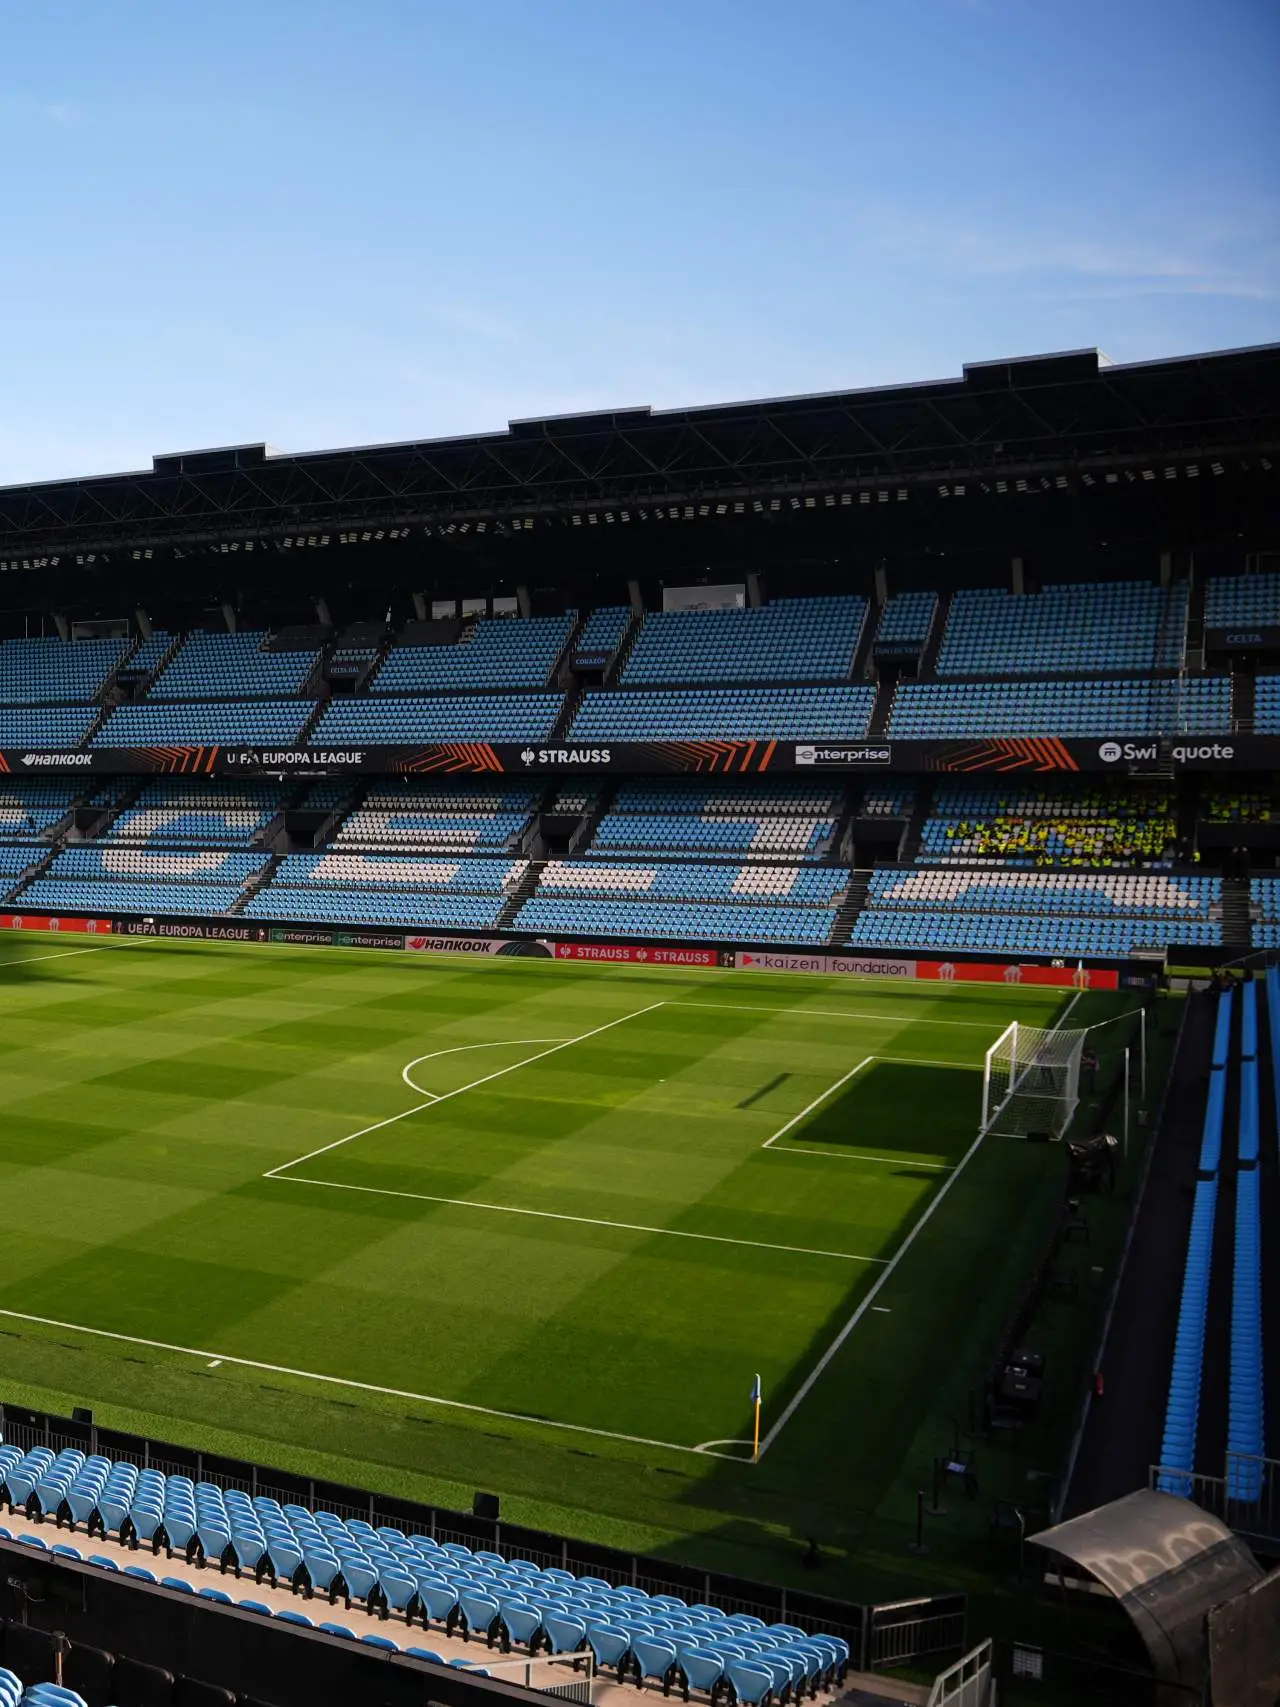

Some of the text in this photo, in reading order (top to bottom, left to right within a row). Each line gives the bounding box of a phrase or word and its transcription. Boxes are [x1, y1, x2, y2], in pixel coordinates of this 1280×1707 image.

[1226, 633, 1262, 645] CELTA
[262, 752, 311, 764] EUROPA
[313, 752, 362, 764] LEAGUE
[538, 749, 611, 764] STRAUSS
[801, 747, 889, 764] enterprise
[1123, 743, 1234, 763] Swiquote
[128, 923, 249, 940] UEFA EUROPA LEAGUE
[277, 931, 332, 945] enterprise
[342, 935, 401, 949] enterprise
[576, 947, 710, 965] STRAUSS STRAUSS
[764, 954, 907, 976] kaizen foundation
